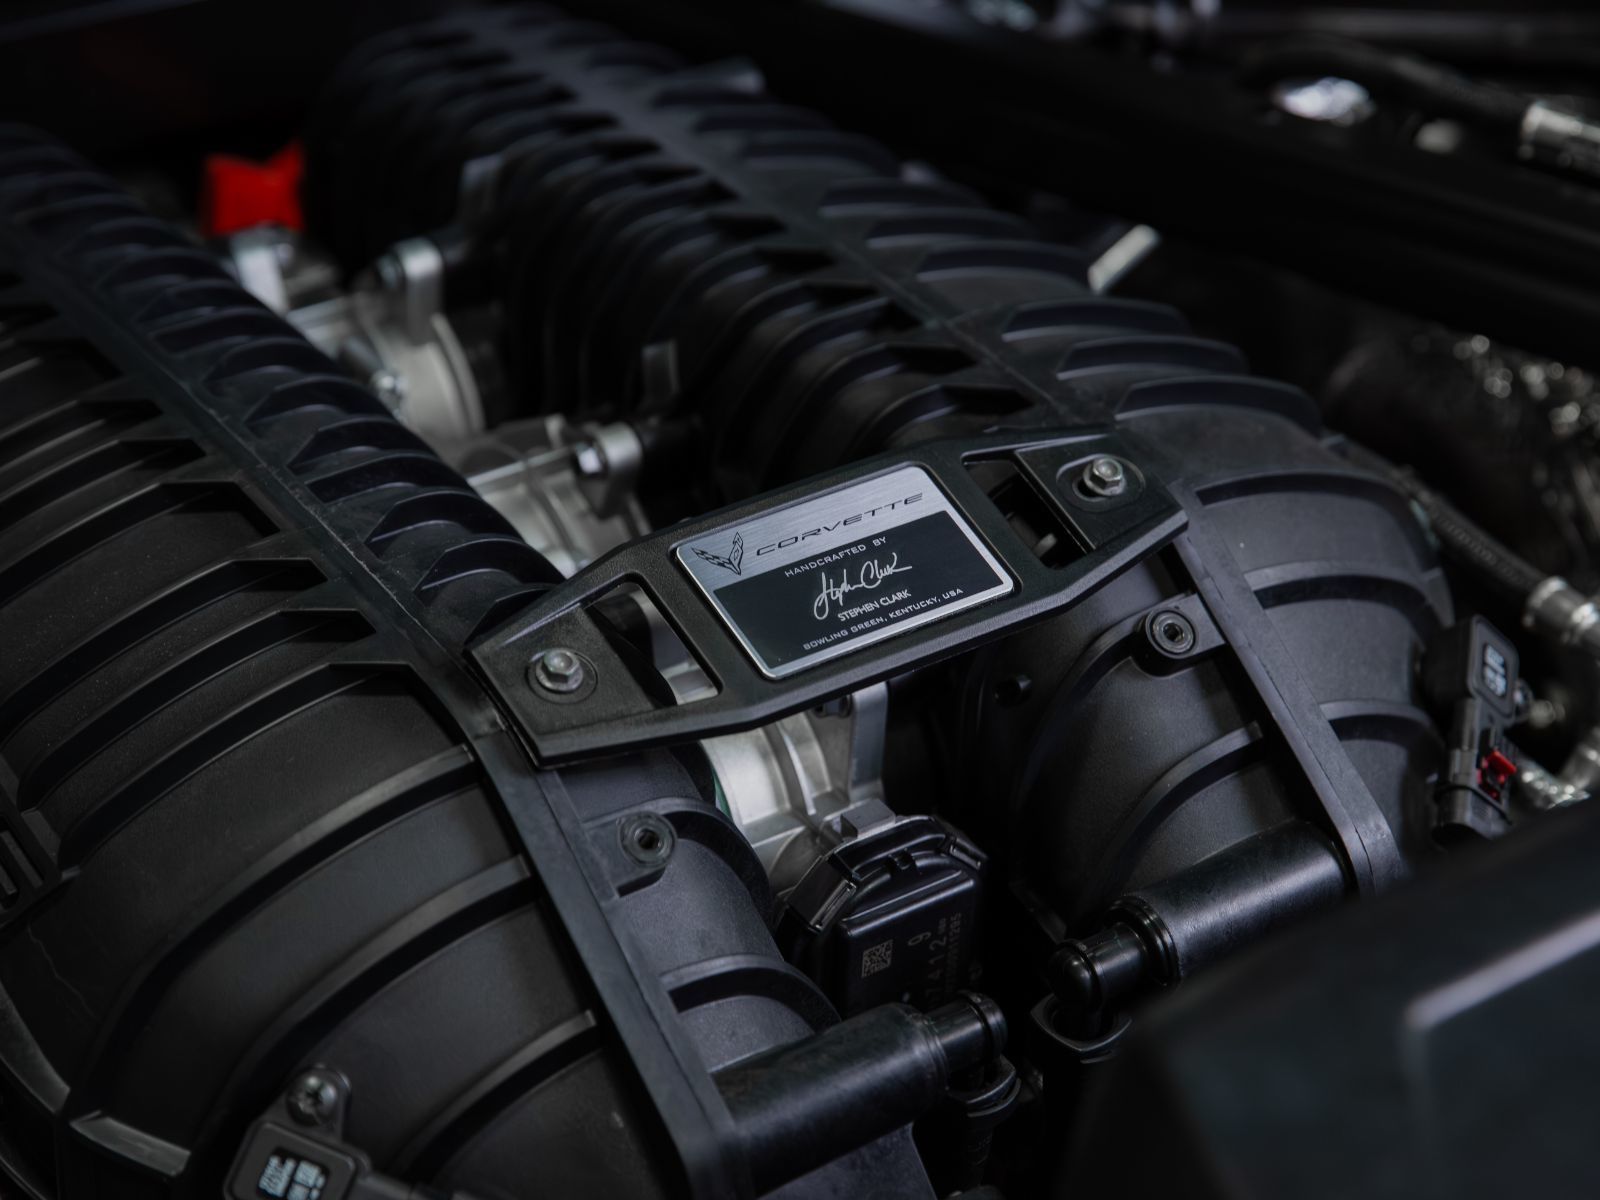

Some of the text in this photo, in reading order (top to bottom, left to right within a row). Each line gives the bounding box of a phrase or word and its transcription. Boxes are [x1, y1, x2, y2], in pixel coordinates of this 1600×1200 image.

[757, 493, 923, 556] CORVETTE
[784, 536, 887, 578] HANDCRAFTED BY
[803, 587, 964, 651] BOWLING GREEN, KENTUCKY, USA
[837, 588, 912, 622] STEPHEN CLARK
